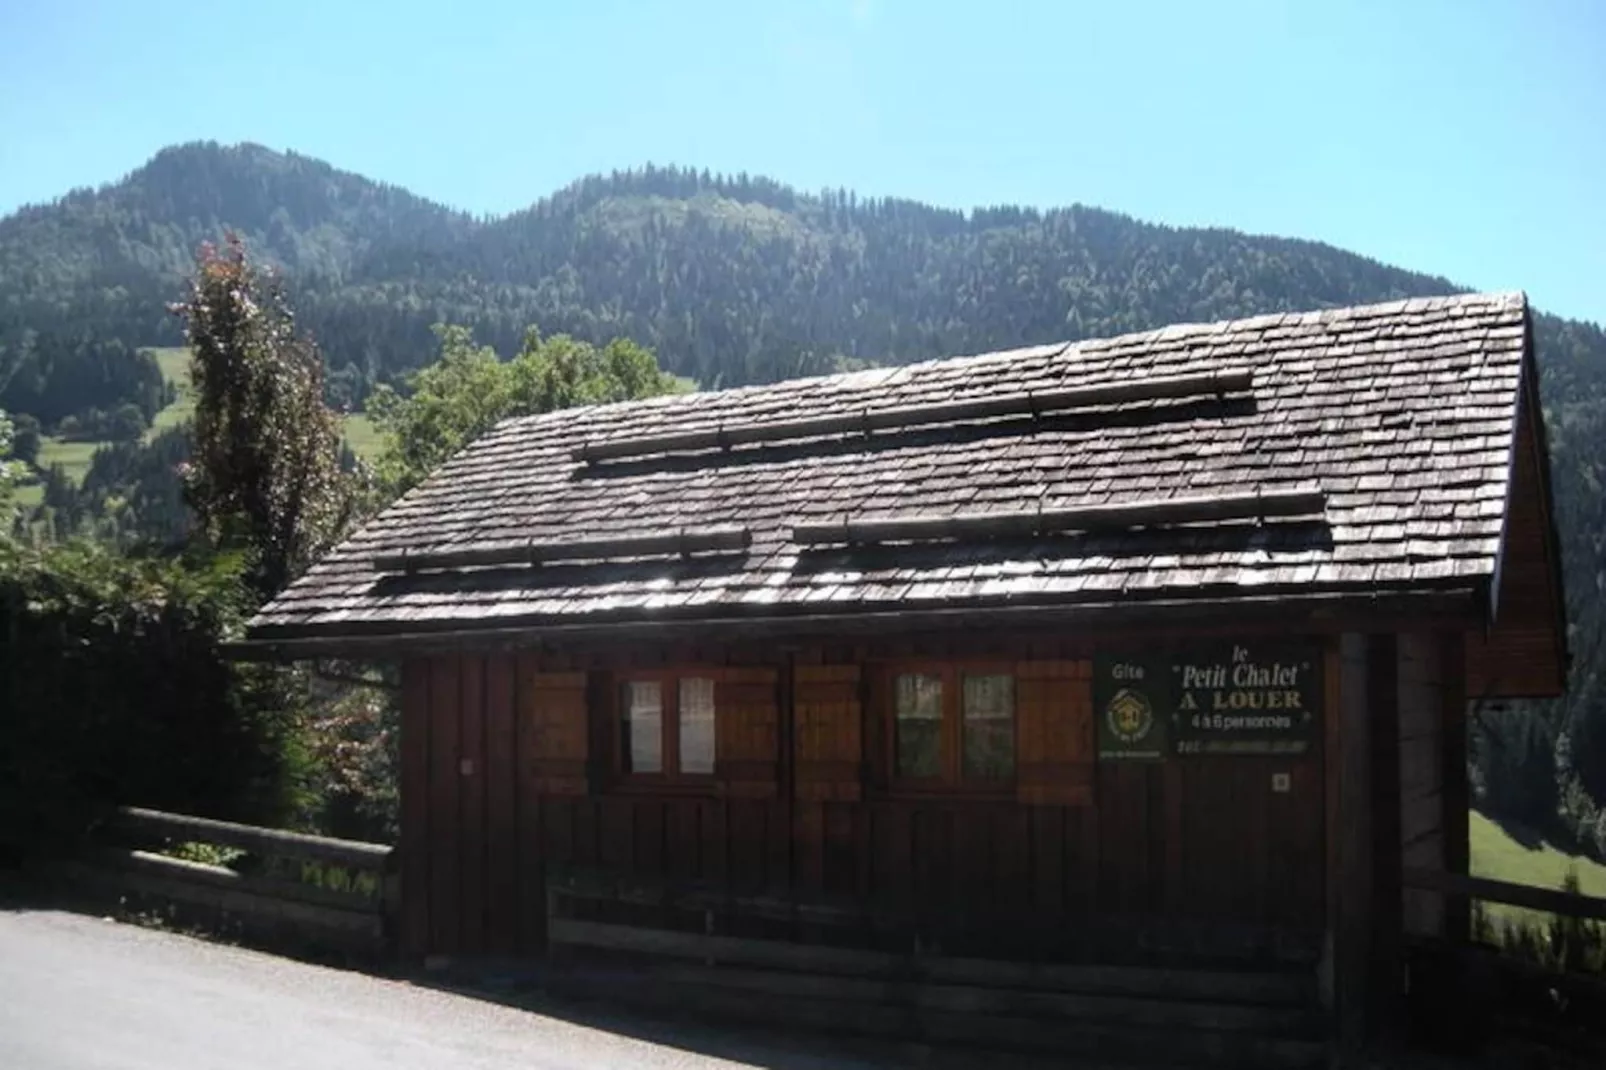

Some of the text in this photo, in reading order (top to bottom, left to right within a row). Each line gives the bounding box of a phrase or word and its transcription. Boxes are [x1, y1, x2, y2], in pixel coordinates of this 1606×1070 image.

[1232, 645, 1248, 662] le
[1183, 663, 1298, 688] Petit Chalet
[1212, 691, 1302, 709] LOUER
